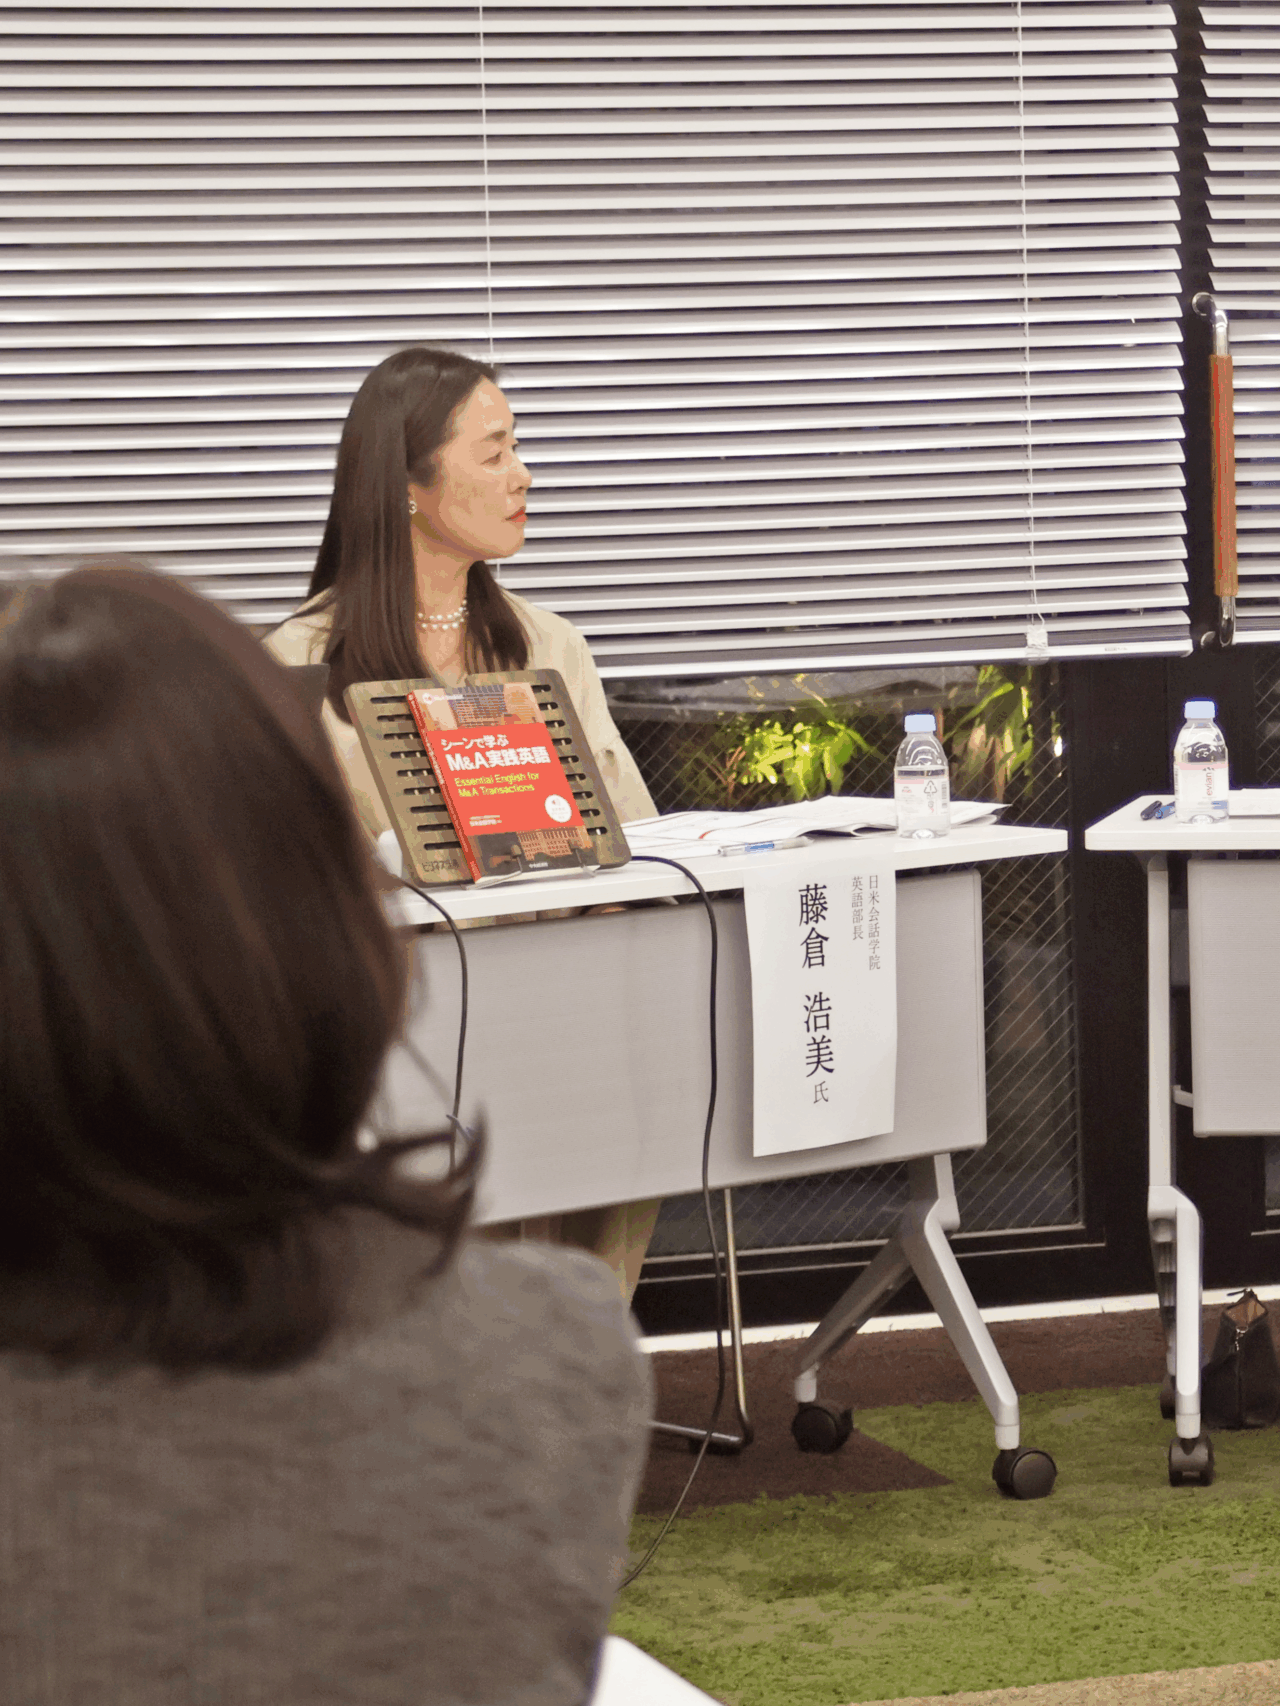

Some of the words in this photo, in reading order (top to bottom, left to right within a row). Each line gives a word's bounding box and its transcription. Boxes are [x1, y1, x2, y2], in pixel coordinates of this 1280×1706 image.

[441, 734, 509, 751] シーンで学ぶ
[445, 746, 551, 771] M&A実践英語
[454, 775, 494, 787] Essential
[494, 772, 526, 785] English
[479, 784, 535, 795] Transactions
[1205, 772, 1213, 796] evian
[851, 876, 864, 941] 英語部長
[868, 874, 881, 971] 日米会話学院
